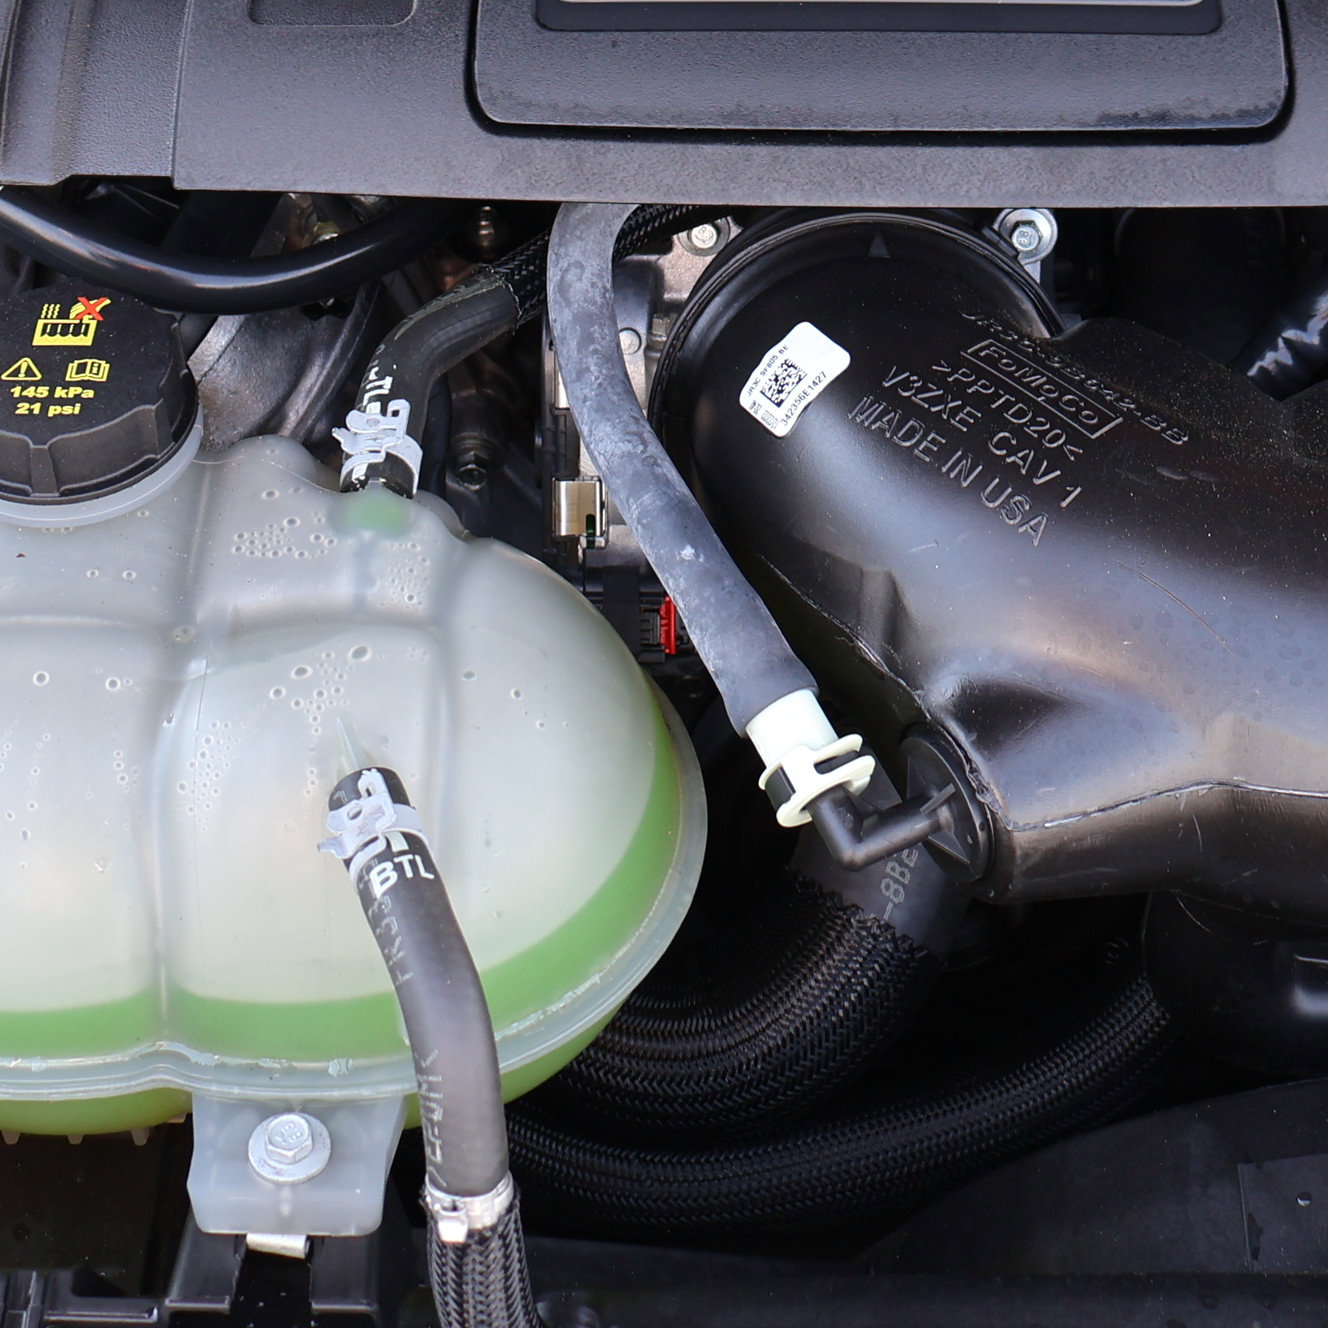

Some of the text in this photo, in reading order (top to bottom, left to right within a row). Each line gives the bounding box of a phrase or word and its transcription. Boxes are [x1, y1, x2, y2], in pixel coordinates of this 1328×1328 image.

[10, 385, 95, 399] 145 kPa
[15, 402, 82, 418] 21 psi
[847, 395, 947, 463] MADE
[941, 449, 984, 488] IN
[980, 476, 1050, 548] USA
[987, 430, 1062, 486] CAV
[1058, 485, 1083, 508] 1
[368, 854, 436, 900] BTL
